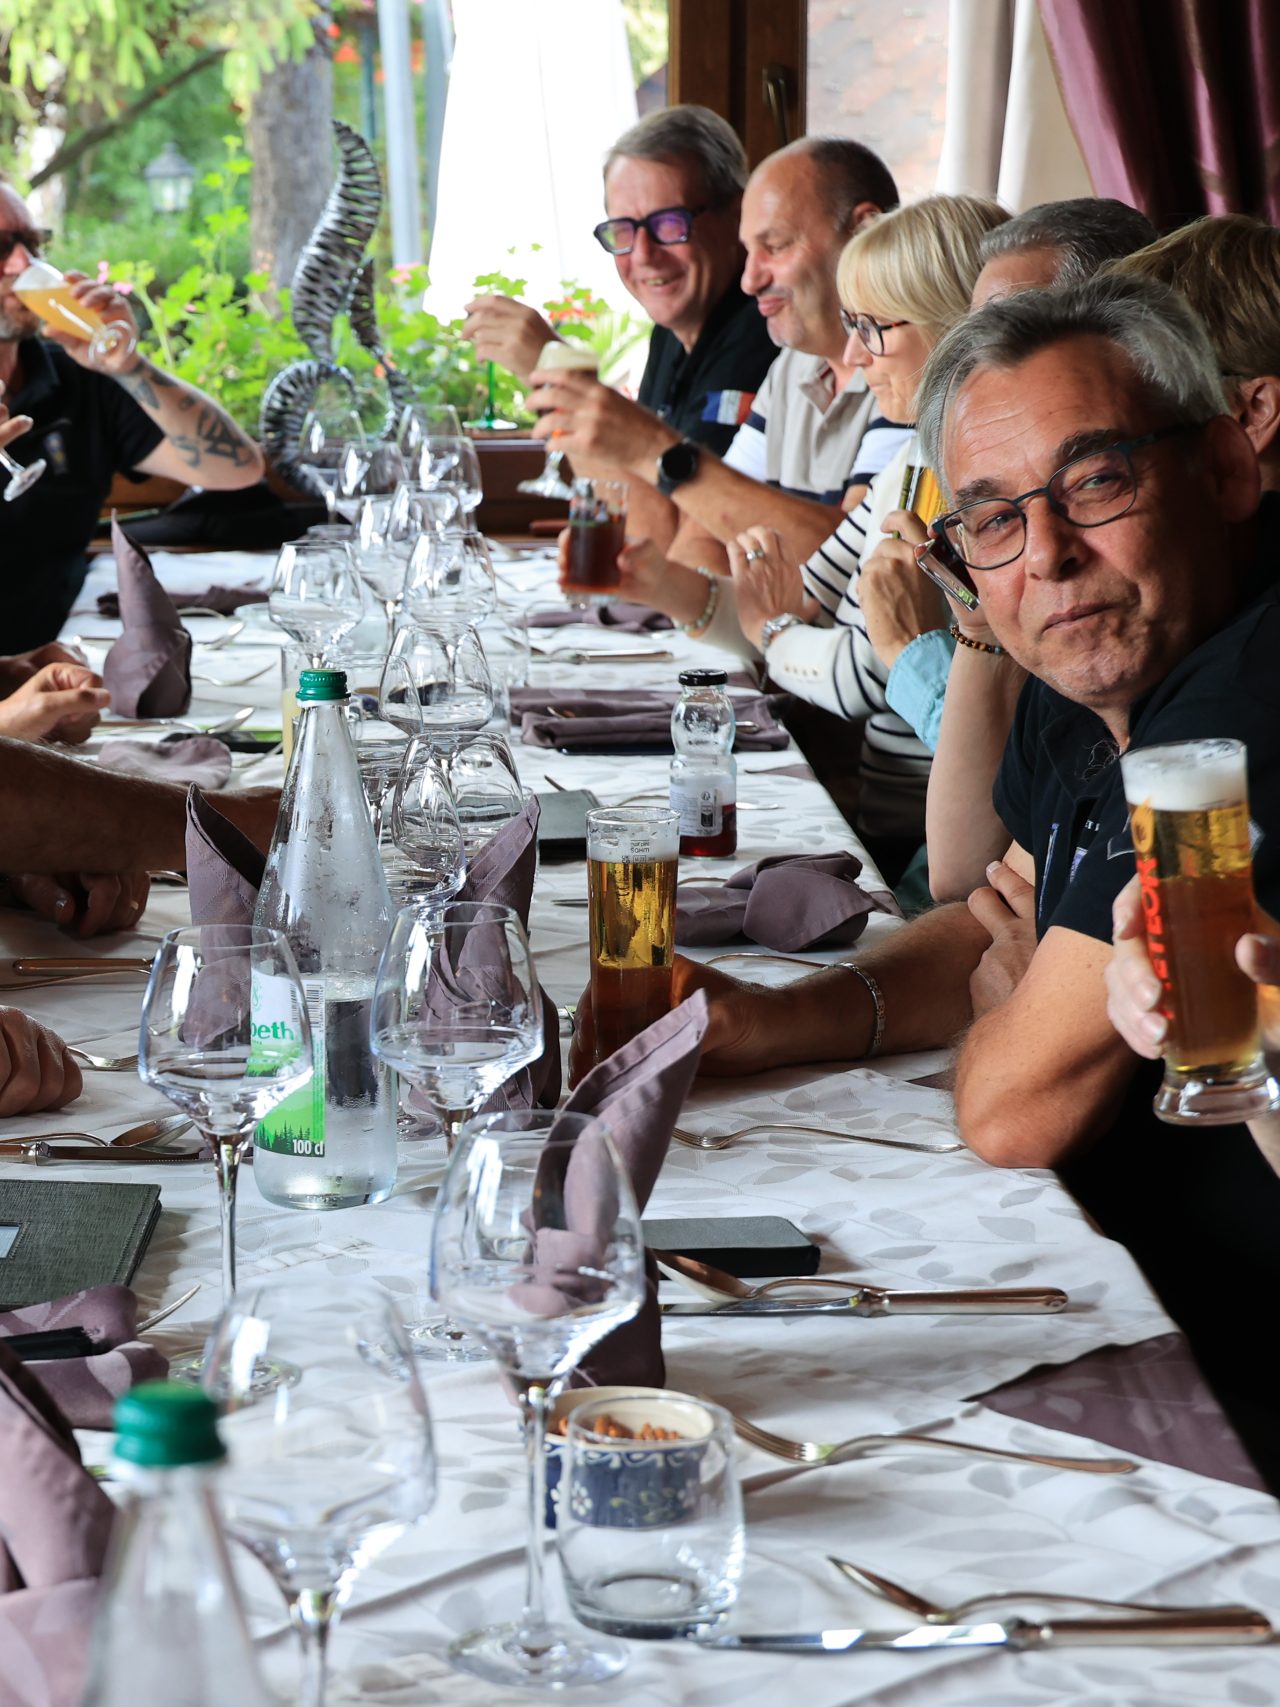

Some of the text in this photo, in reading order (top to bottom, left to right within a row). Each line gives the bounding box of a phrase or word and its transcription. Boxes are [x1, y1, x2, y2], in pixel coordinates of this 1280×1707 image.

[1137, 858, 1174, 1020] ETEOR
[292, 1138, 324, 1156] 100 cl
